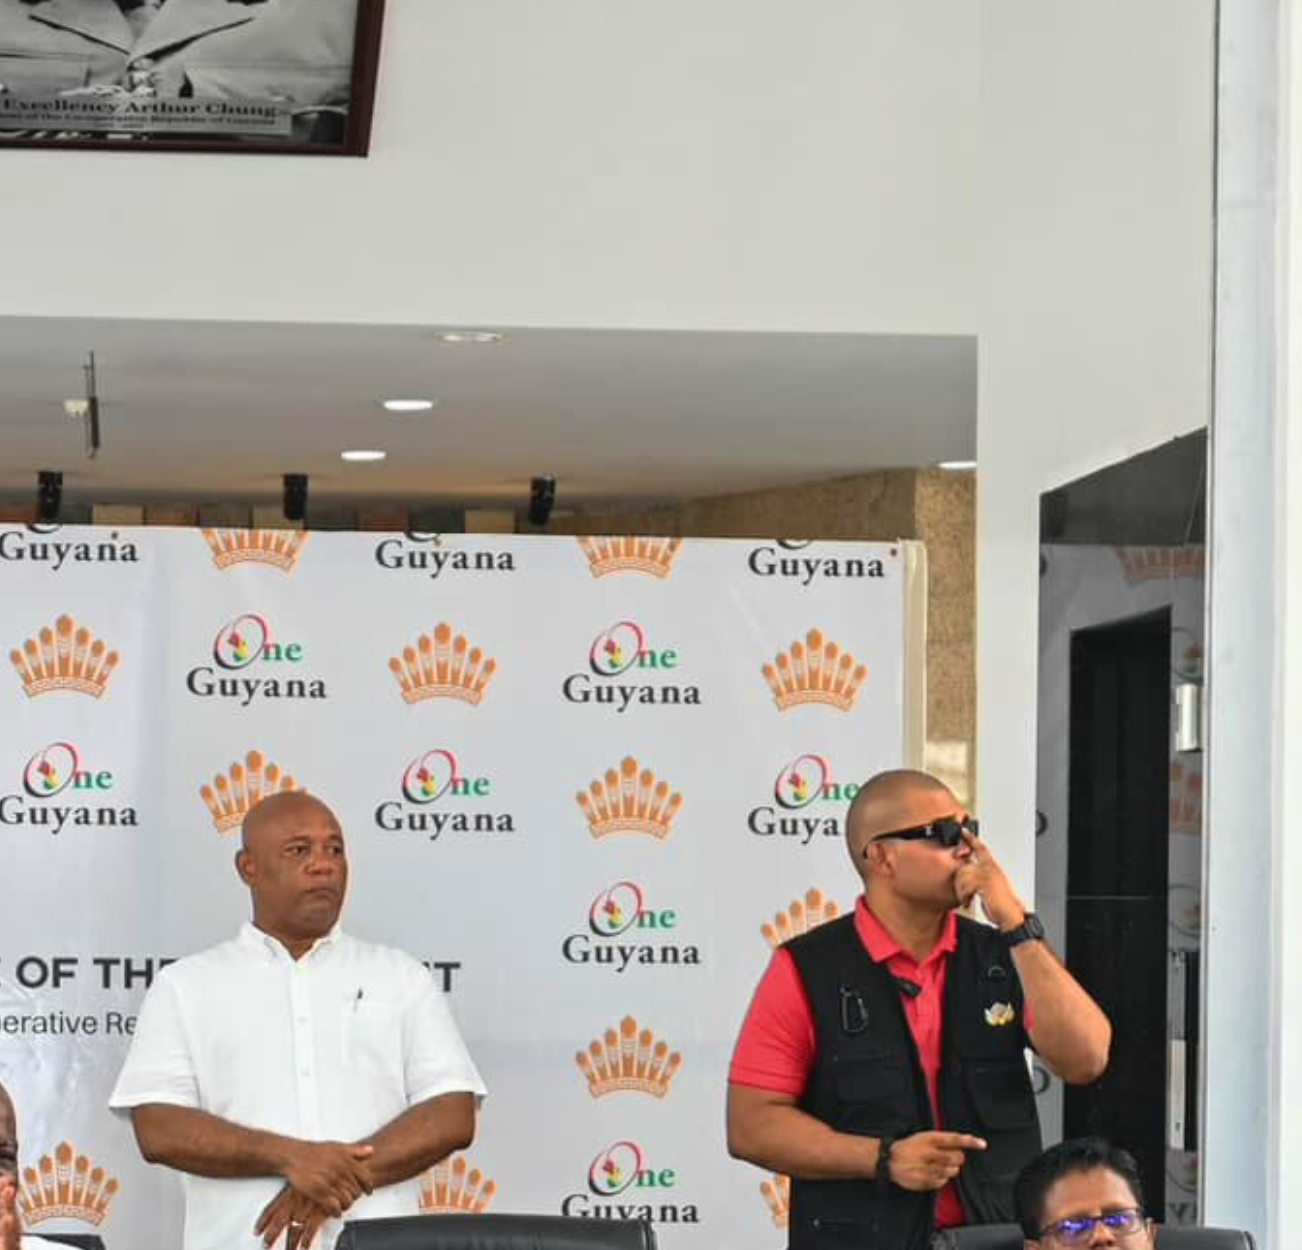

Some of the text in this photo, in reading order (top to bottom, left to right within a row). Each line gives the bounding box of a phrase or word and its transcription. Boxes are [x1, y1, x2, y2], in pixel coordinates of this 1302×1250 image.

[375, 540, 515, 577] Guyana
[748, 547, 884, 584] Guyana
[213, 614, 302, 670] One
[589, 621, 677, 676] One
[186, 667, 327, 706] Guyana
[563, 674, 702, 712] Guyana
[23, 742, 112, 797] One
[402, 749, 490, 804] One
[375, 802, 515, 840] Guyana
[748, 806, 840, 845] Guya
[589, 882, 676, 937] One
[563, 934, 701, 972] Guyana
[15, 956, 78, 989] OF
[93, 957, 175, 990] TH
[588, 1141, 675, 1196] One
